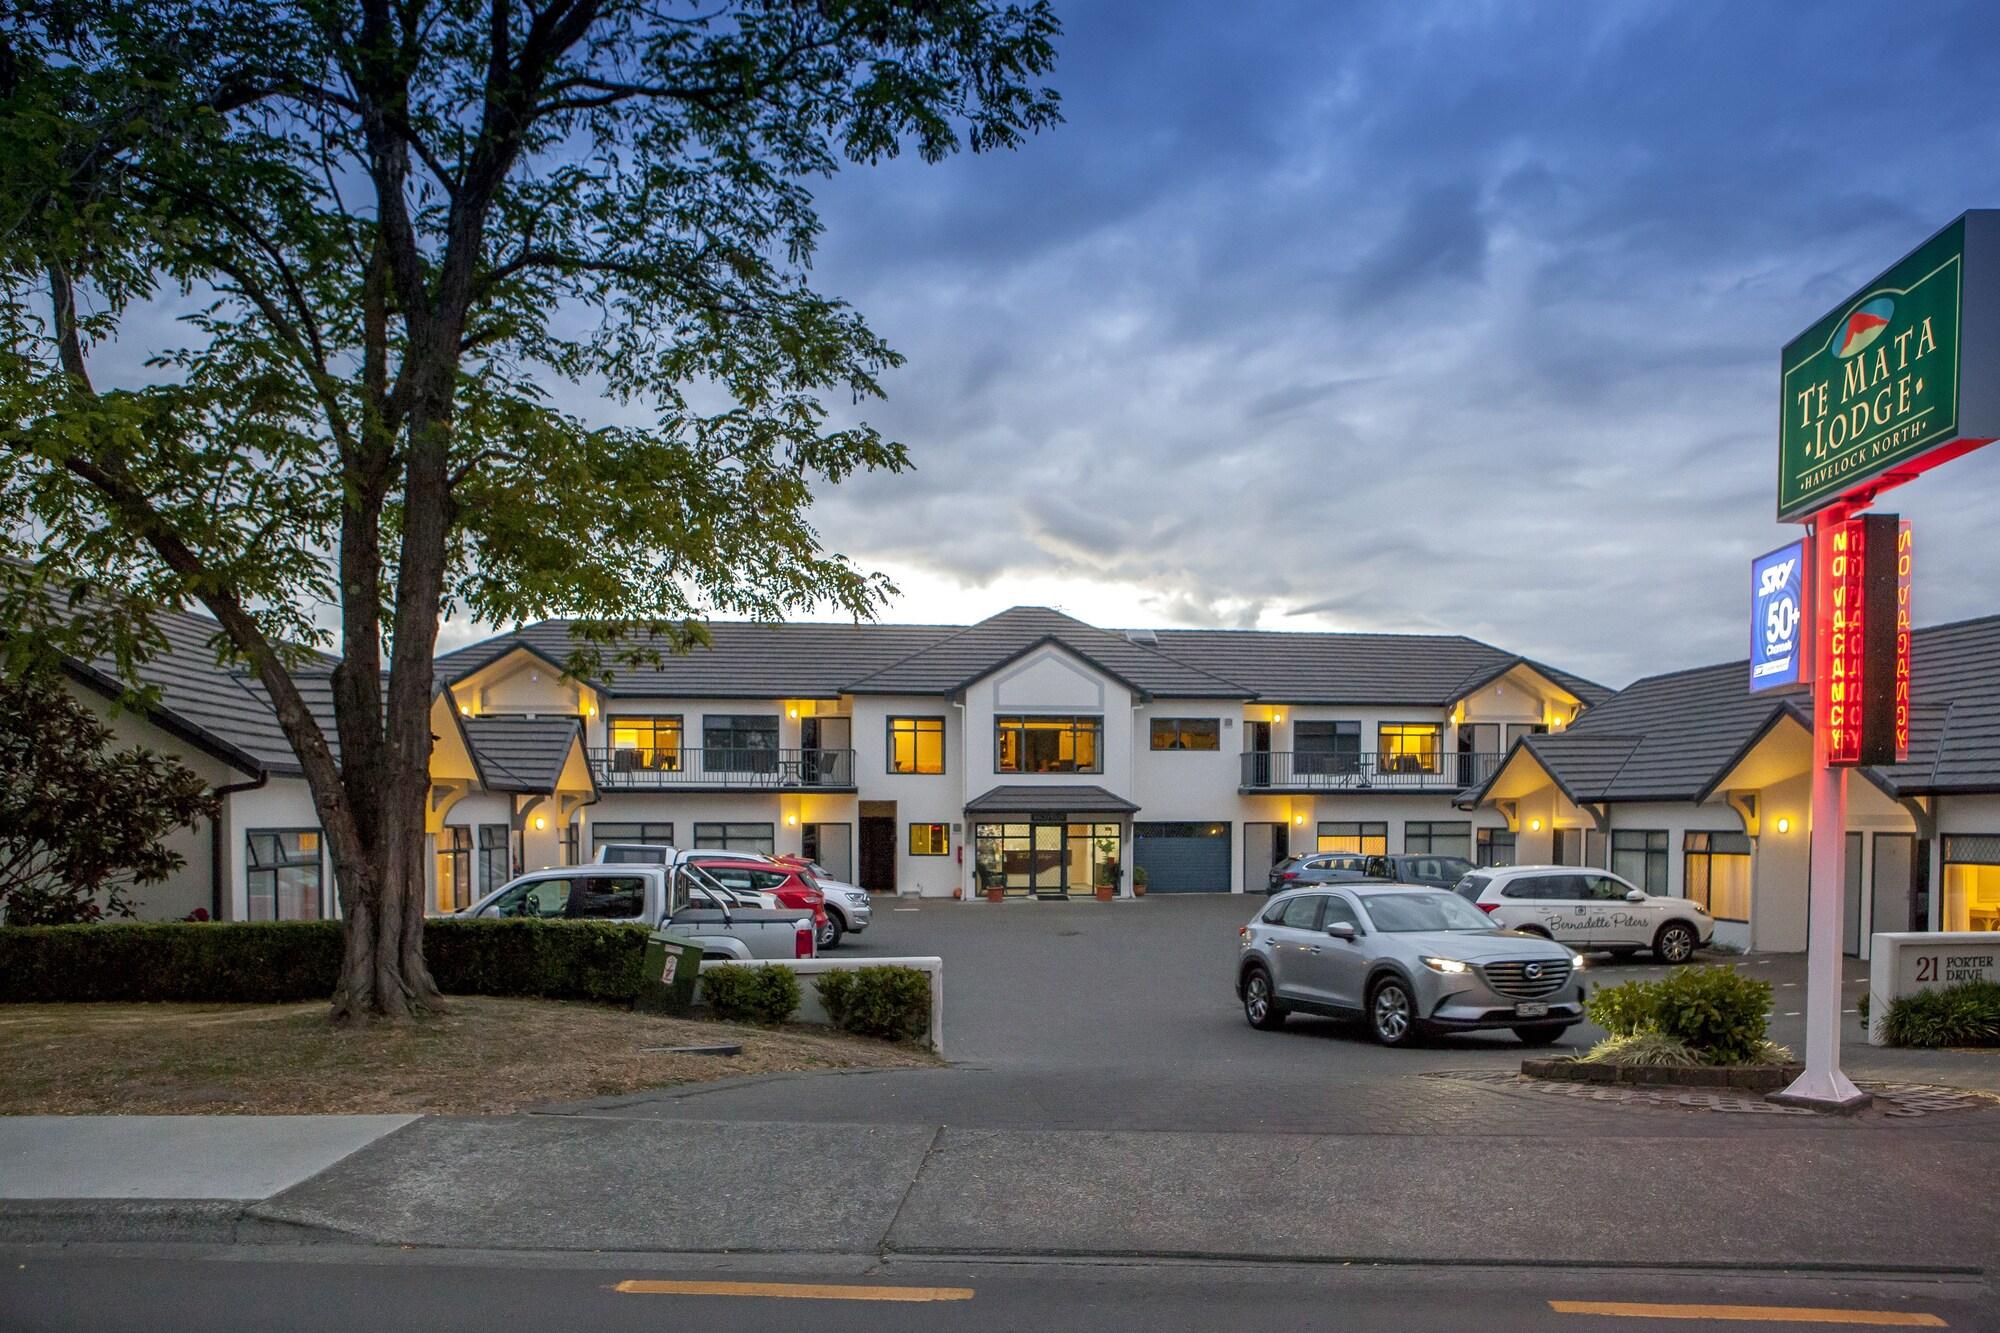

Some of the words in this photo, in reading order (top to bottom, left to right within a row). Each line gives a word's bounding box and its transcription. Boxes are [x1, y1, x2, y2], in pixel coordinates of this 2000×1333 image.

[1798, 380, 1829, 429] TE
[1840, 316, 1937, 404] MATA
[1814, 373, 1912, 461] LODGE
[1804, 448, 1867, 490] HAVELOCK
[1871, 421, 1921, 459] NORTH
[1832, 531, 1848, 577] NO
[1758, 558, 1796, 597] SKY
[1766, 597, 1800, 643] 50+
[1831, 586, 1846, 750] VACANCY
[1545, 915, 1610, 931] Bernadette
[1610, 912, 1649, 928] Peters
[1916, 956, 1939, 982] 21
[1946, 956, 1994, 968] PORTER
[1946, 969, 1983, 981] DRIVE
